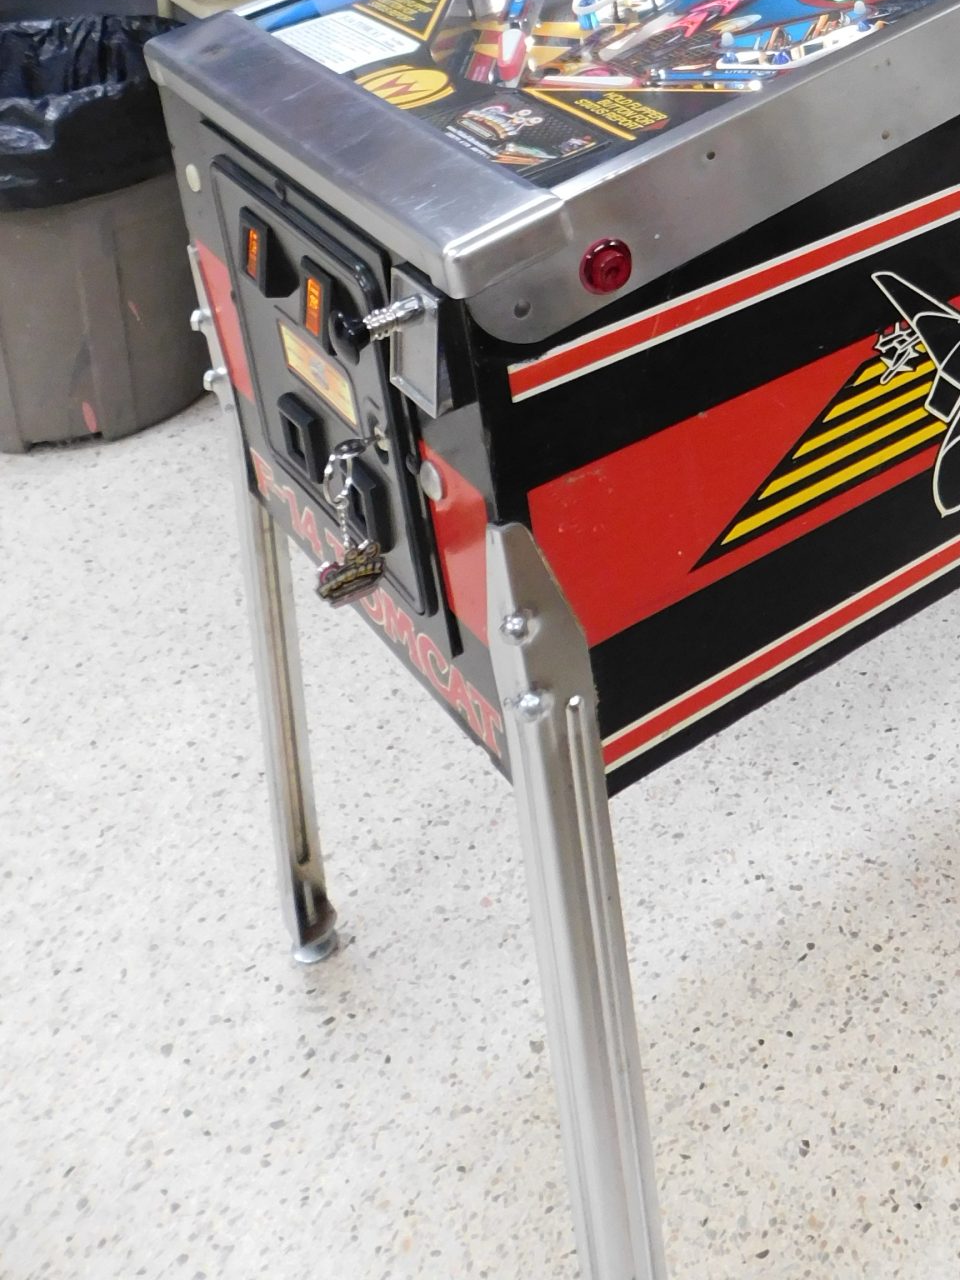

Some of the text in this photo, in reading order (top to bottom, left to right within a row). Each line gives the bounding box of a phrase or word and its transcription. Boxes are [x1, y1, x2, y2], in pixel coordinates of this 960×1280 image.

[603, 91, 633, 105] HOLD
[630, 113, 655, 125] FOR
[250, 447, 326, 561] F-14
